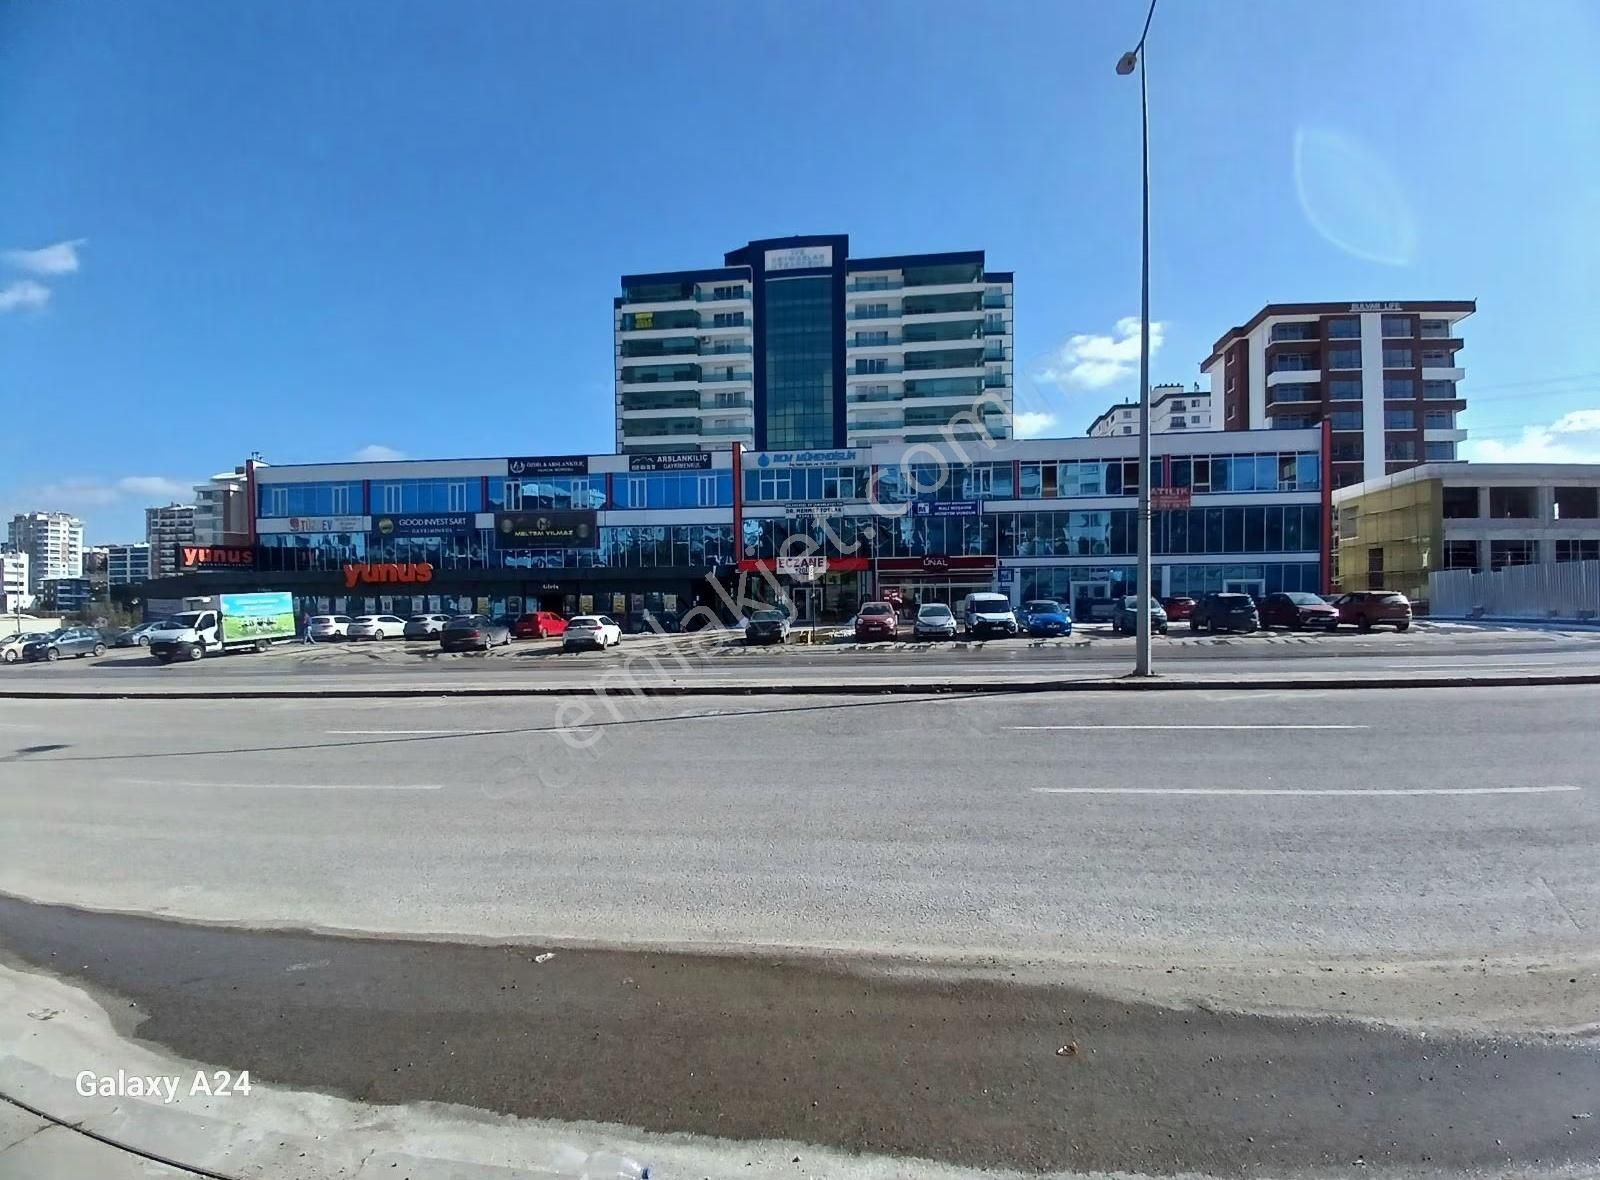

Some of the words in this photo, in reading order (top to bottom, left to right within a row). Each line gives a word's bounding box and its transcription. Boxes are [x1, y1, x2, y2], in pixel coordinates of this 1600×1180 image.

[184, 547, 253, 566] yunus
[778, 557, 825, 568] ECZANE
[923, 557, 949, 566] ÜNAL
[343, 563, 434, 588] yunus
